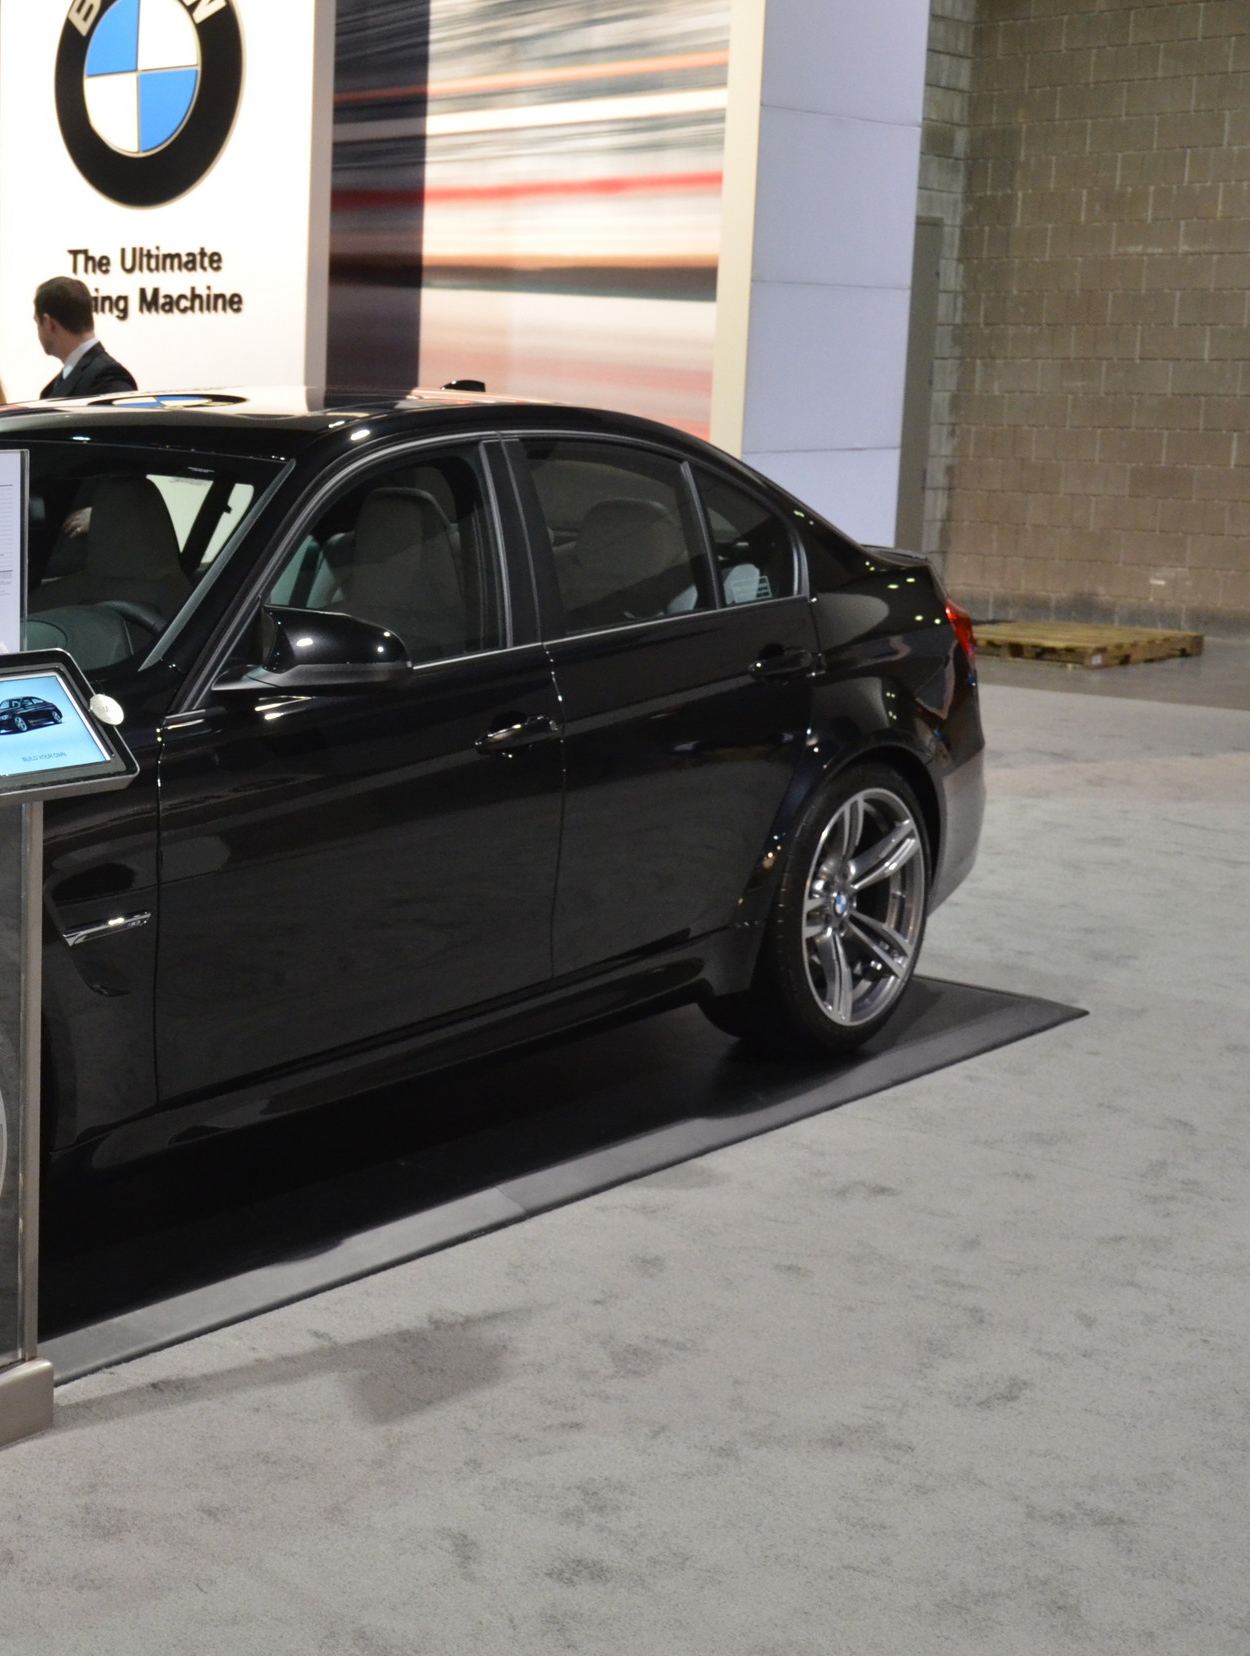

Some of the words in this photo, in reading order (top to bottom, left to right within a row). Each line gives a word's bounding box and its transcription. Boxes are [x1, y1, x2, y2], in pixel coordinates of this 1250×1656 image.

[67, 249, 111, 275] The
[121, 246, 223, 274] Ultimate
[138, 285, 243, 314] Machine
